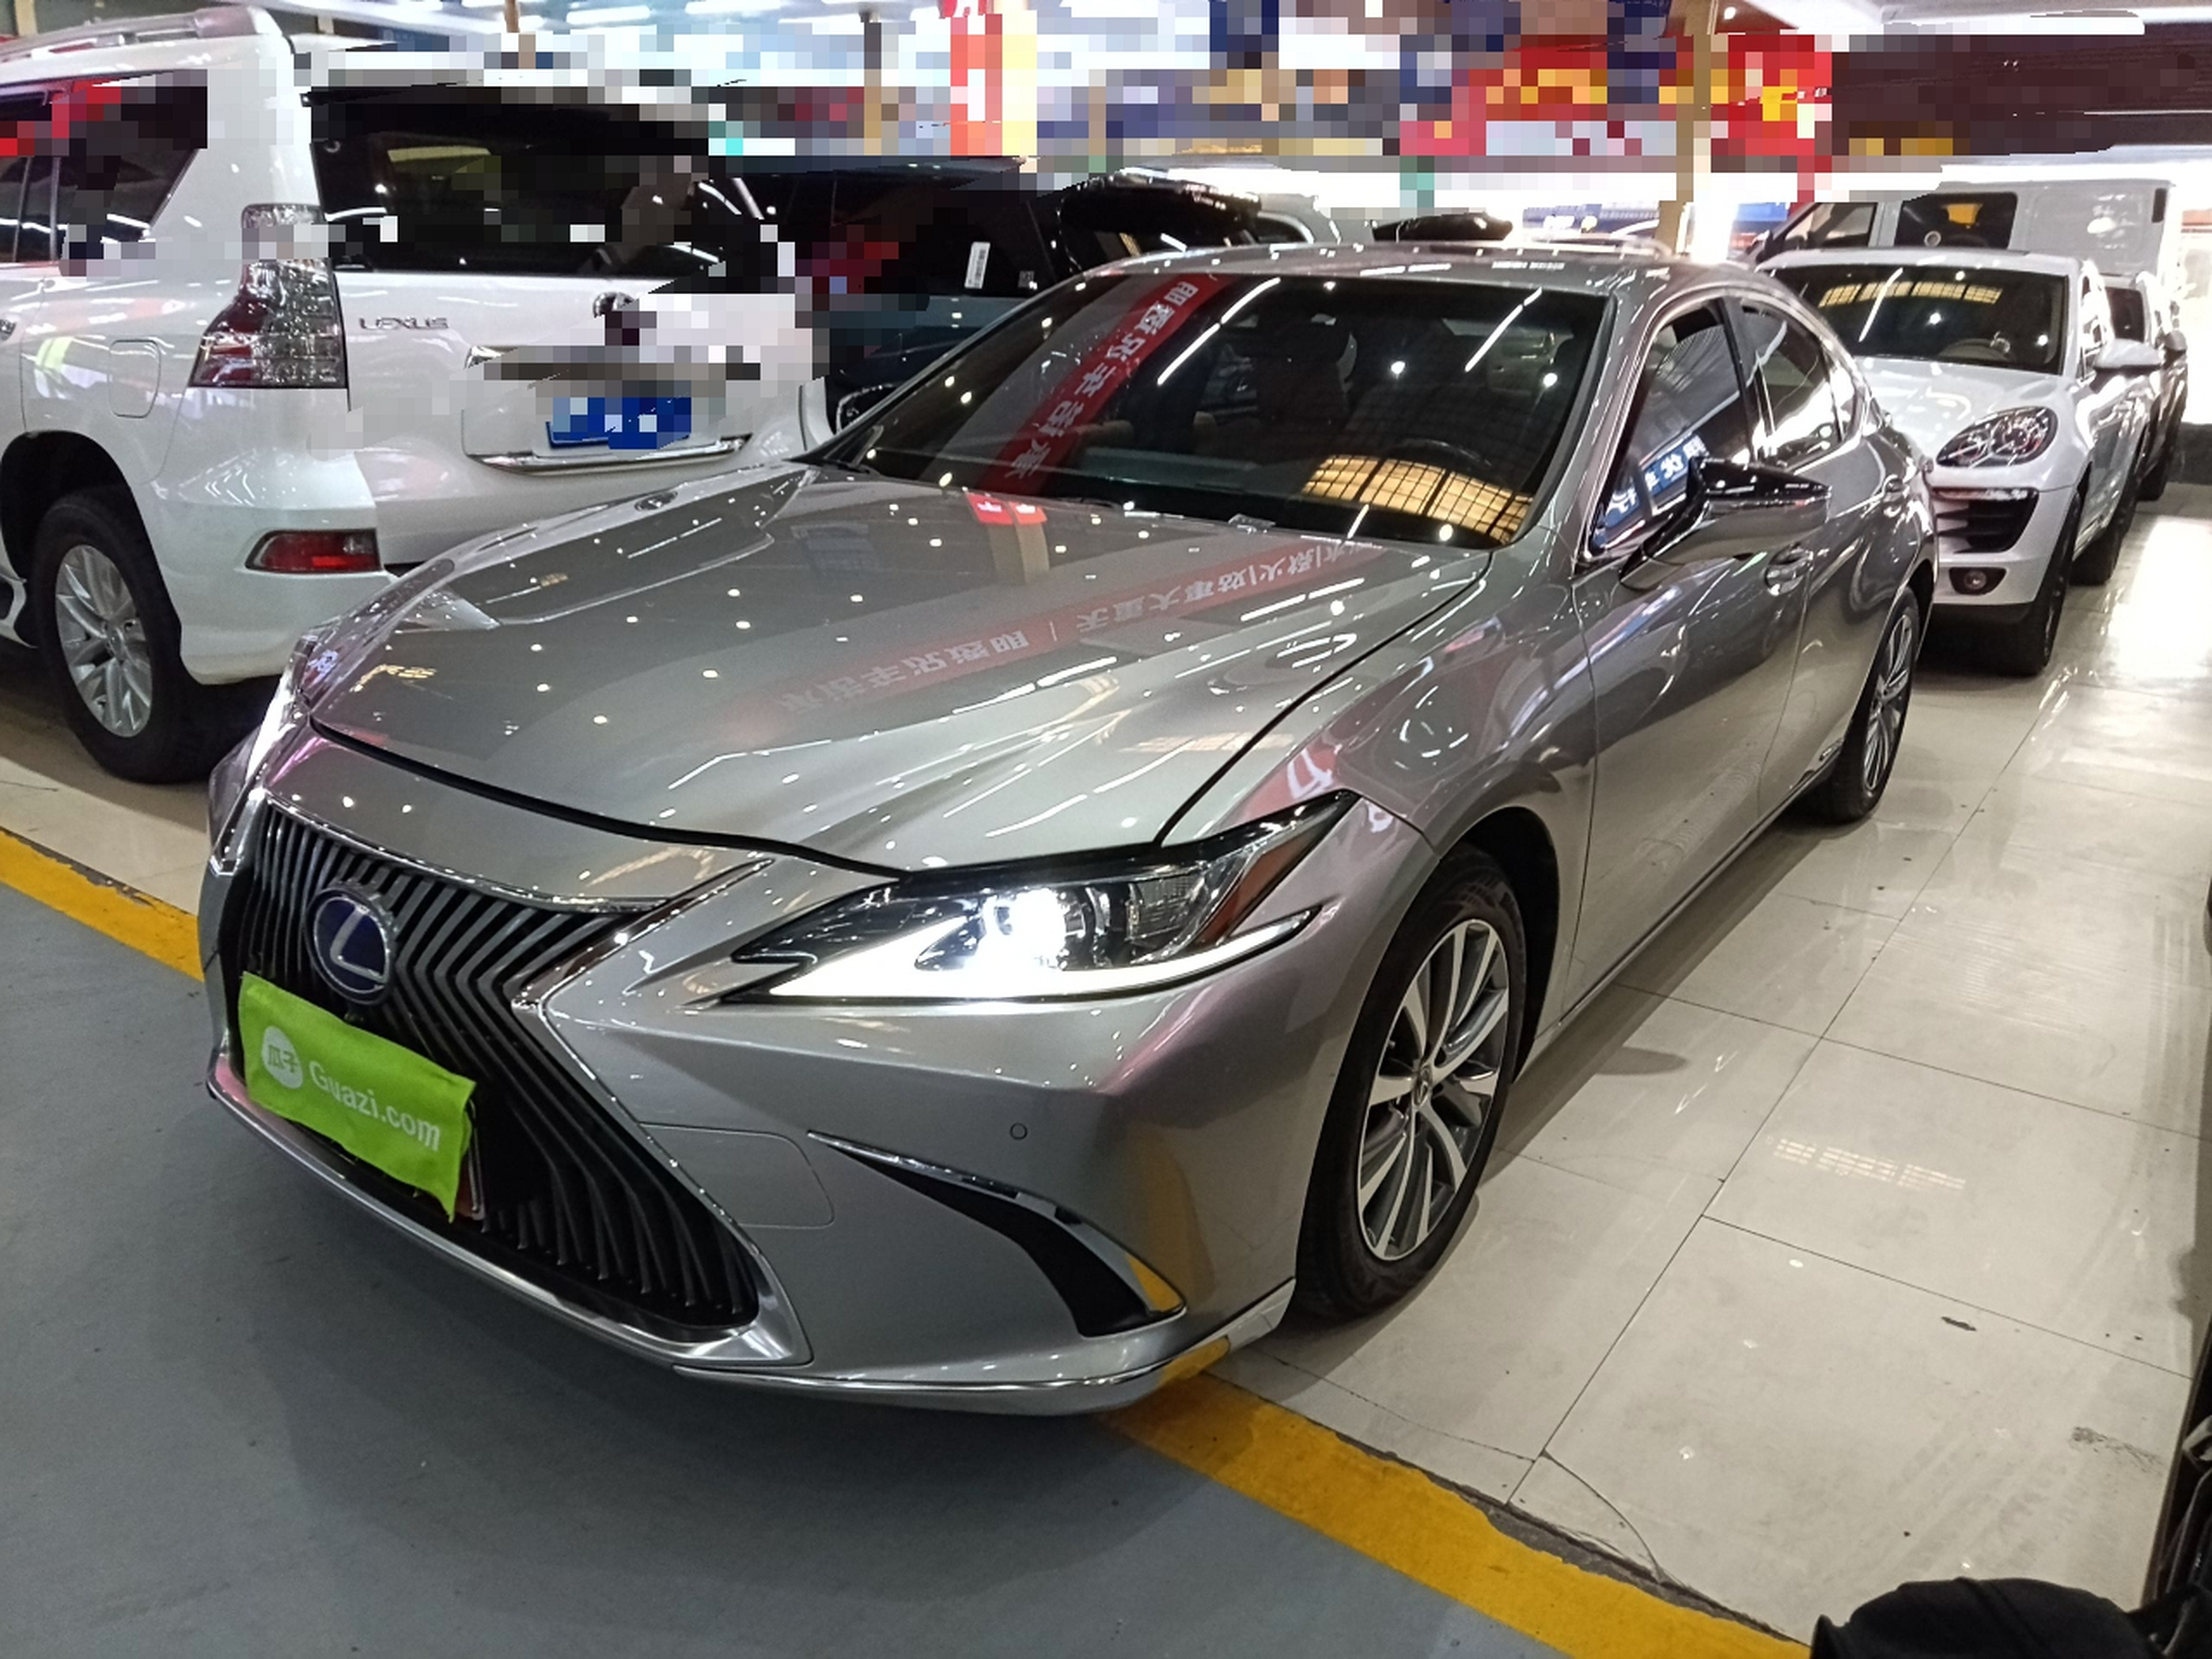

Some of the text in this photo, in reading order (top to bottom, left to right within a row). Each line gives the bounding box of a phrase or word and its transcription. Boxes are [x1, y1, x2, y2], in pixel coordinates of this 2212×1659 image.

[359, 317, 449, 330] LEXUS
[267, 1044, 441, 1152] 瓜子 Guazi.com
